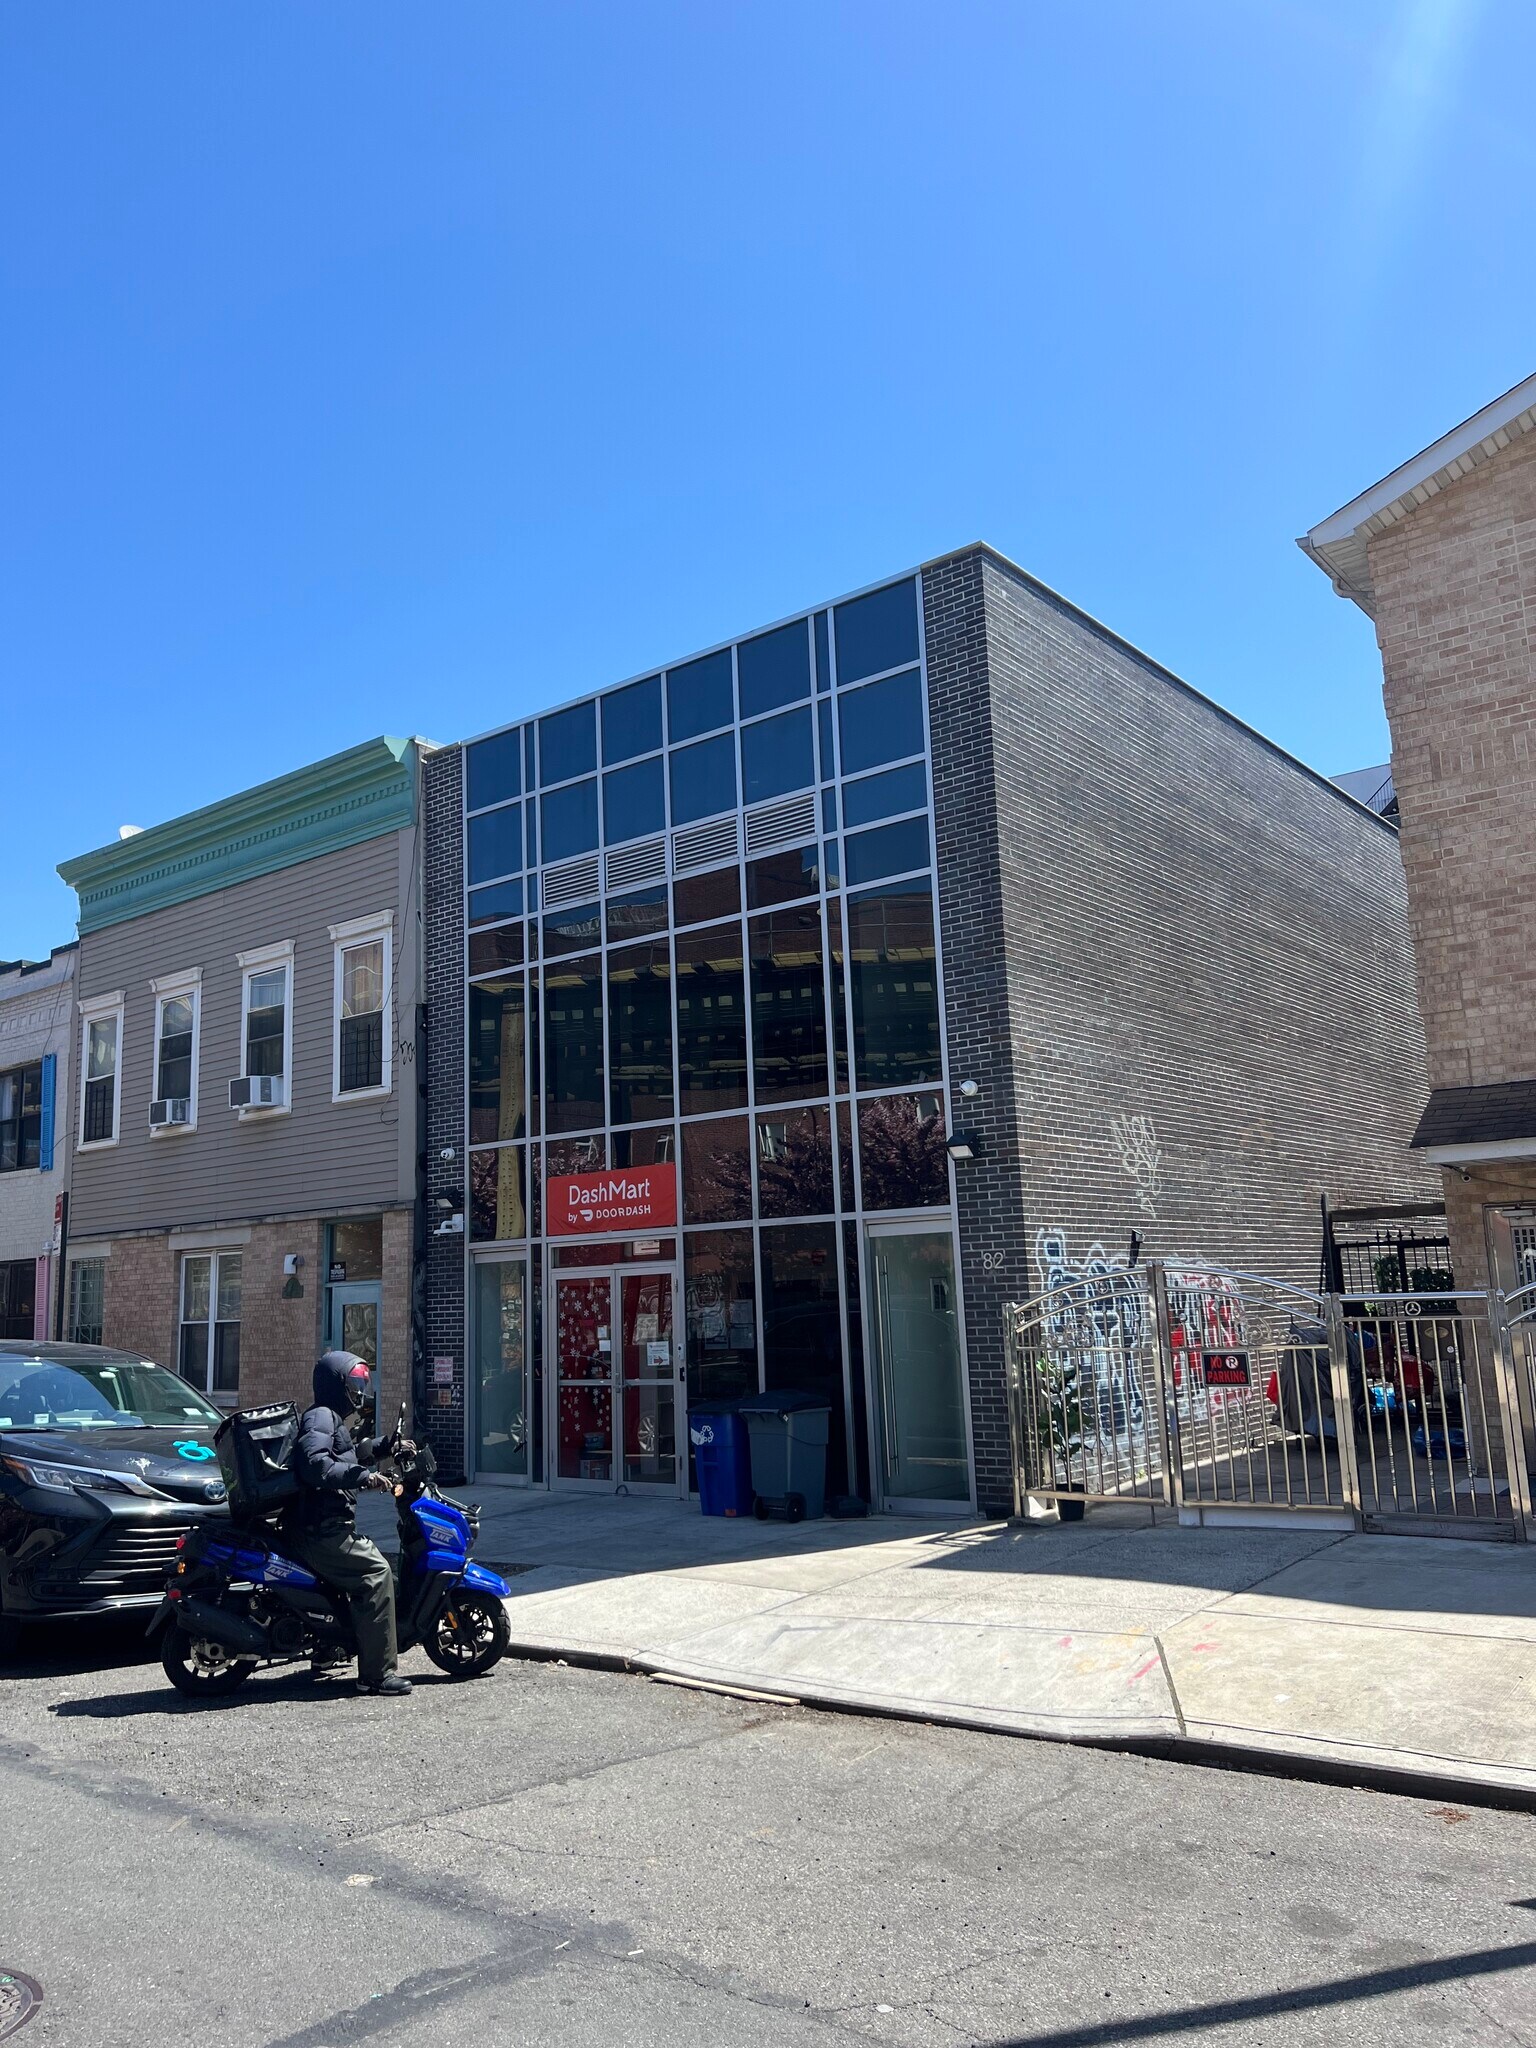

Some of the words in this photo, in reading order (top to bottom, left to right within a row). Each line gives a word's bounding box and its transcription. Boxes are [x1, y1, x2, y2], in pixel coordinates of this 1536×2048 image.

[568, 1178, 651, 1206] DashMart
[567, 1212, 578, 1224] by
[595, 1204, 652, 1219] DOORDASH
[983, 1252, 1005, 1270] 82
[1210, 1355, 1223, 1369] NO
[1206, 1370, 1247, 1383] PARKING
[430, 1528, 453, 1543] TANK
[265, 1563, 292, 1578] TANK
